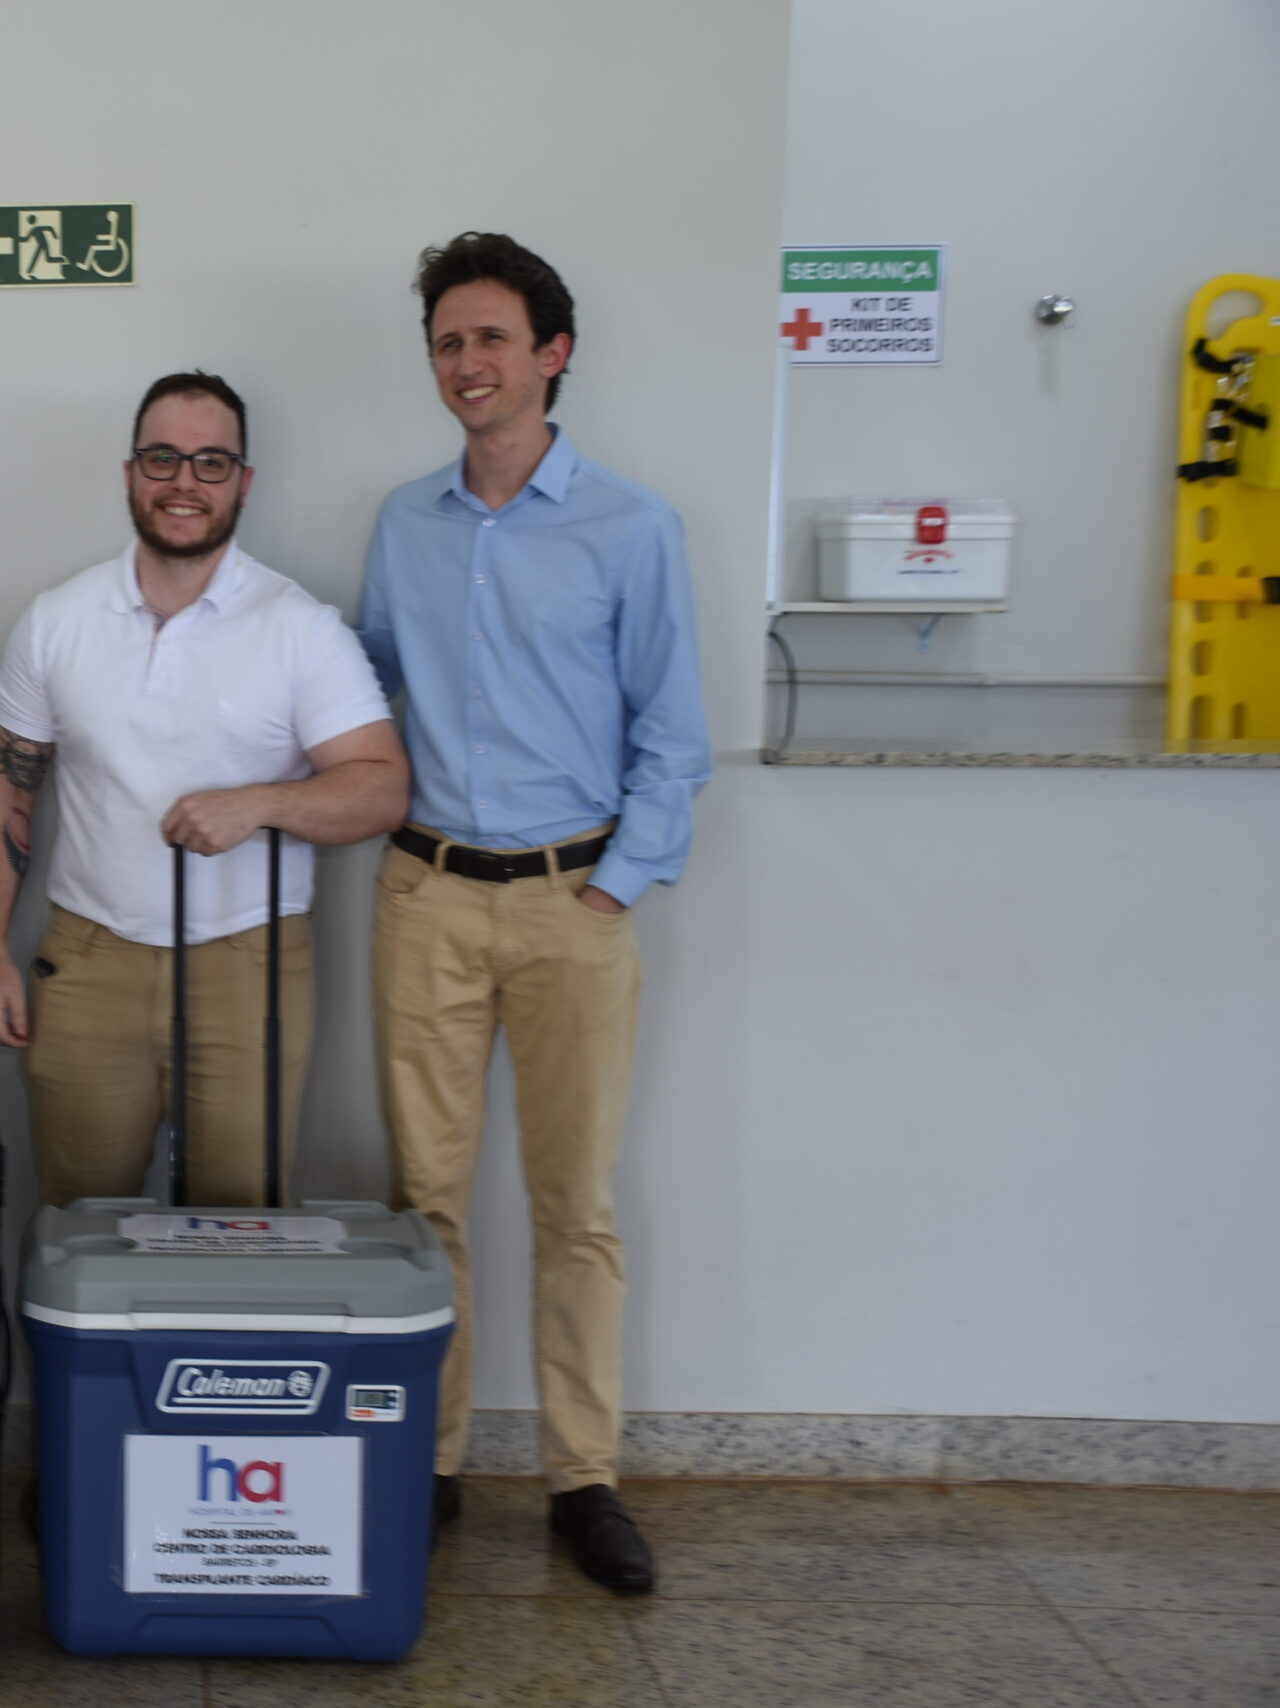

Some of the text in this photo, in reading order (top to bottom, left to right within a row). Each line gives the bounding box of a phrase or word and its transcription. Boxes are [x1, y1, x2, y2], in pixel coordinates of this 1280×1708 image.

[787, 260, 933, 284] SEGURANÇA
[850, 297, 913, 312] KIT DE
[829, 317, 933, 332] PRIMEIROS
[826, 338, 933, 352] SOCORROS
[177, 1367, 286, 1397] Coleman
[197, 1444, 284, 1502] ha
[182, 1529, 298, 1541] NOSSA SENHORA
[153, 1542, 332, 1556] CENTRO DE CARDIOLOGIA
[153, 1572, 254, 1585] TRANSPLANTE
